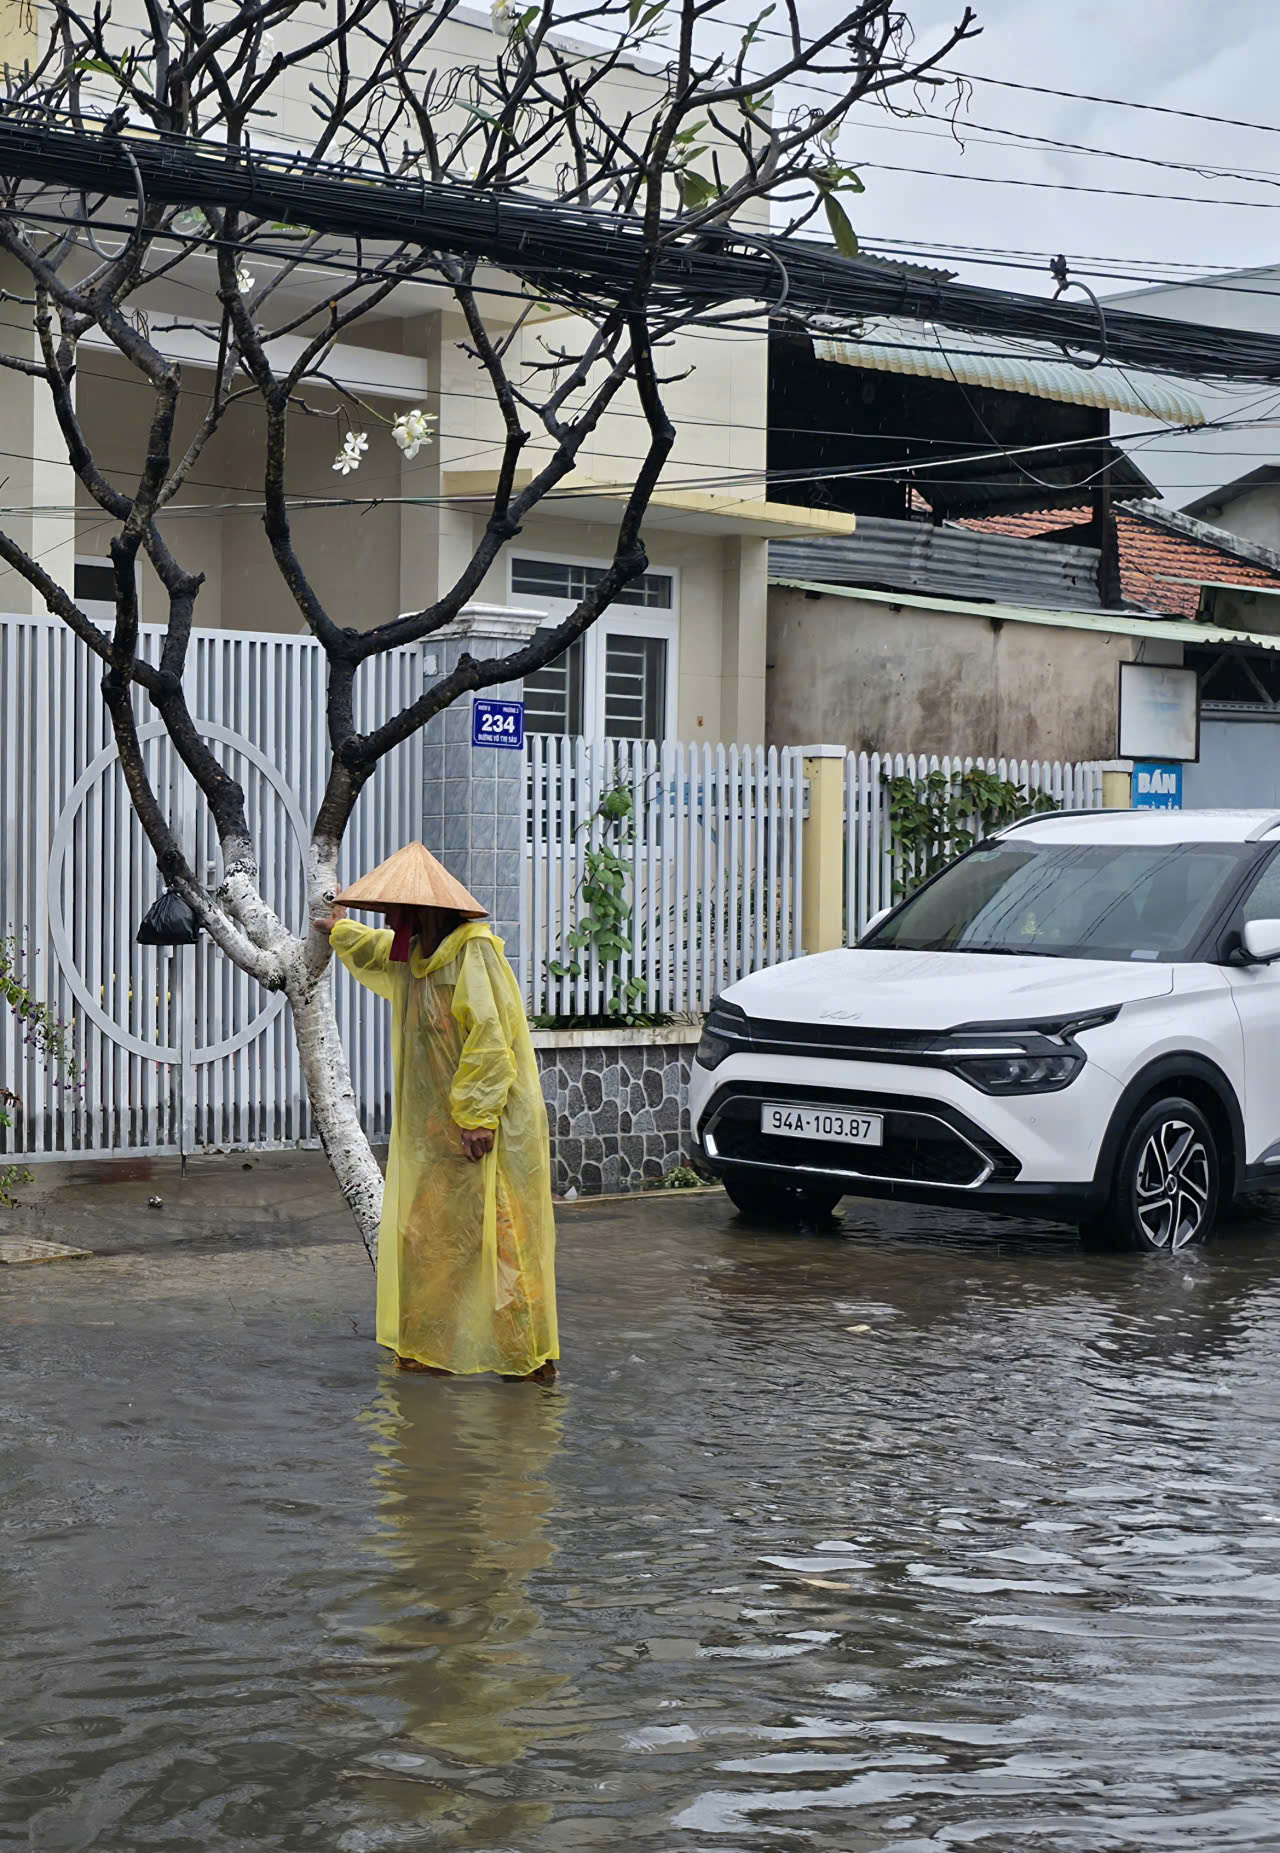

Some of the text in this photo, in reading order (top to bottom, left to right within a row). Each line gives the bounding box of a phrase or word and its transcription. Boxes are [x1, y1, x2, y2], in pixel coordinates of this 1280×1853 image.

[482, 714, 515, 733] 234
[1137, 769, 1176, 794] BÁN
[772, 1110, 872, 1139] 94A-103.87
